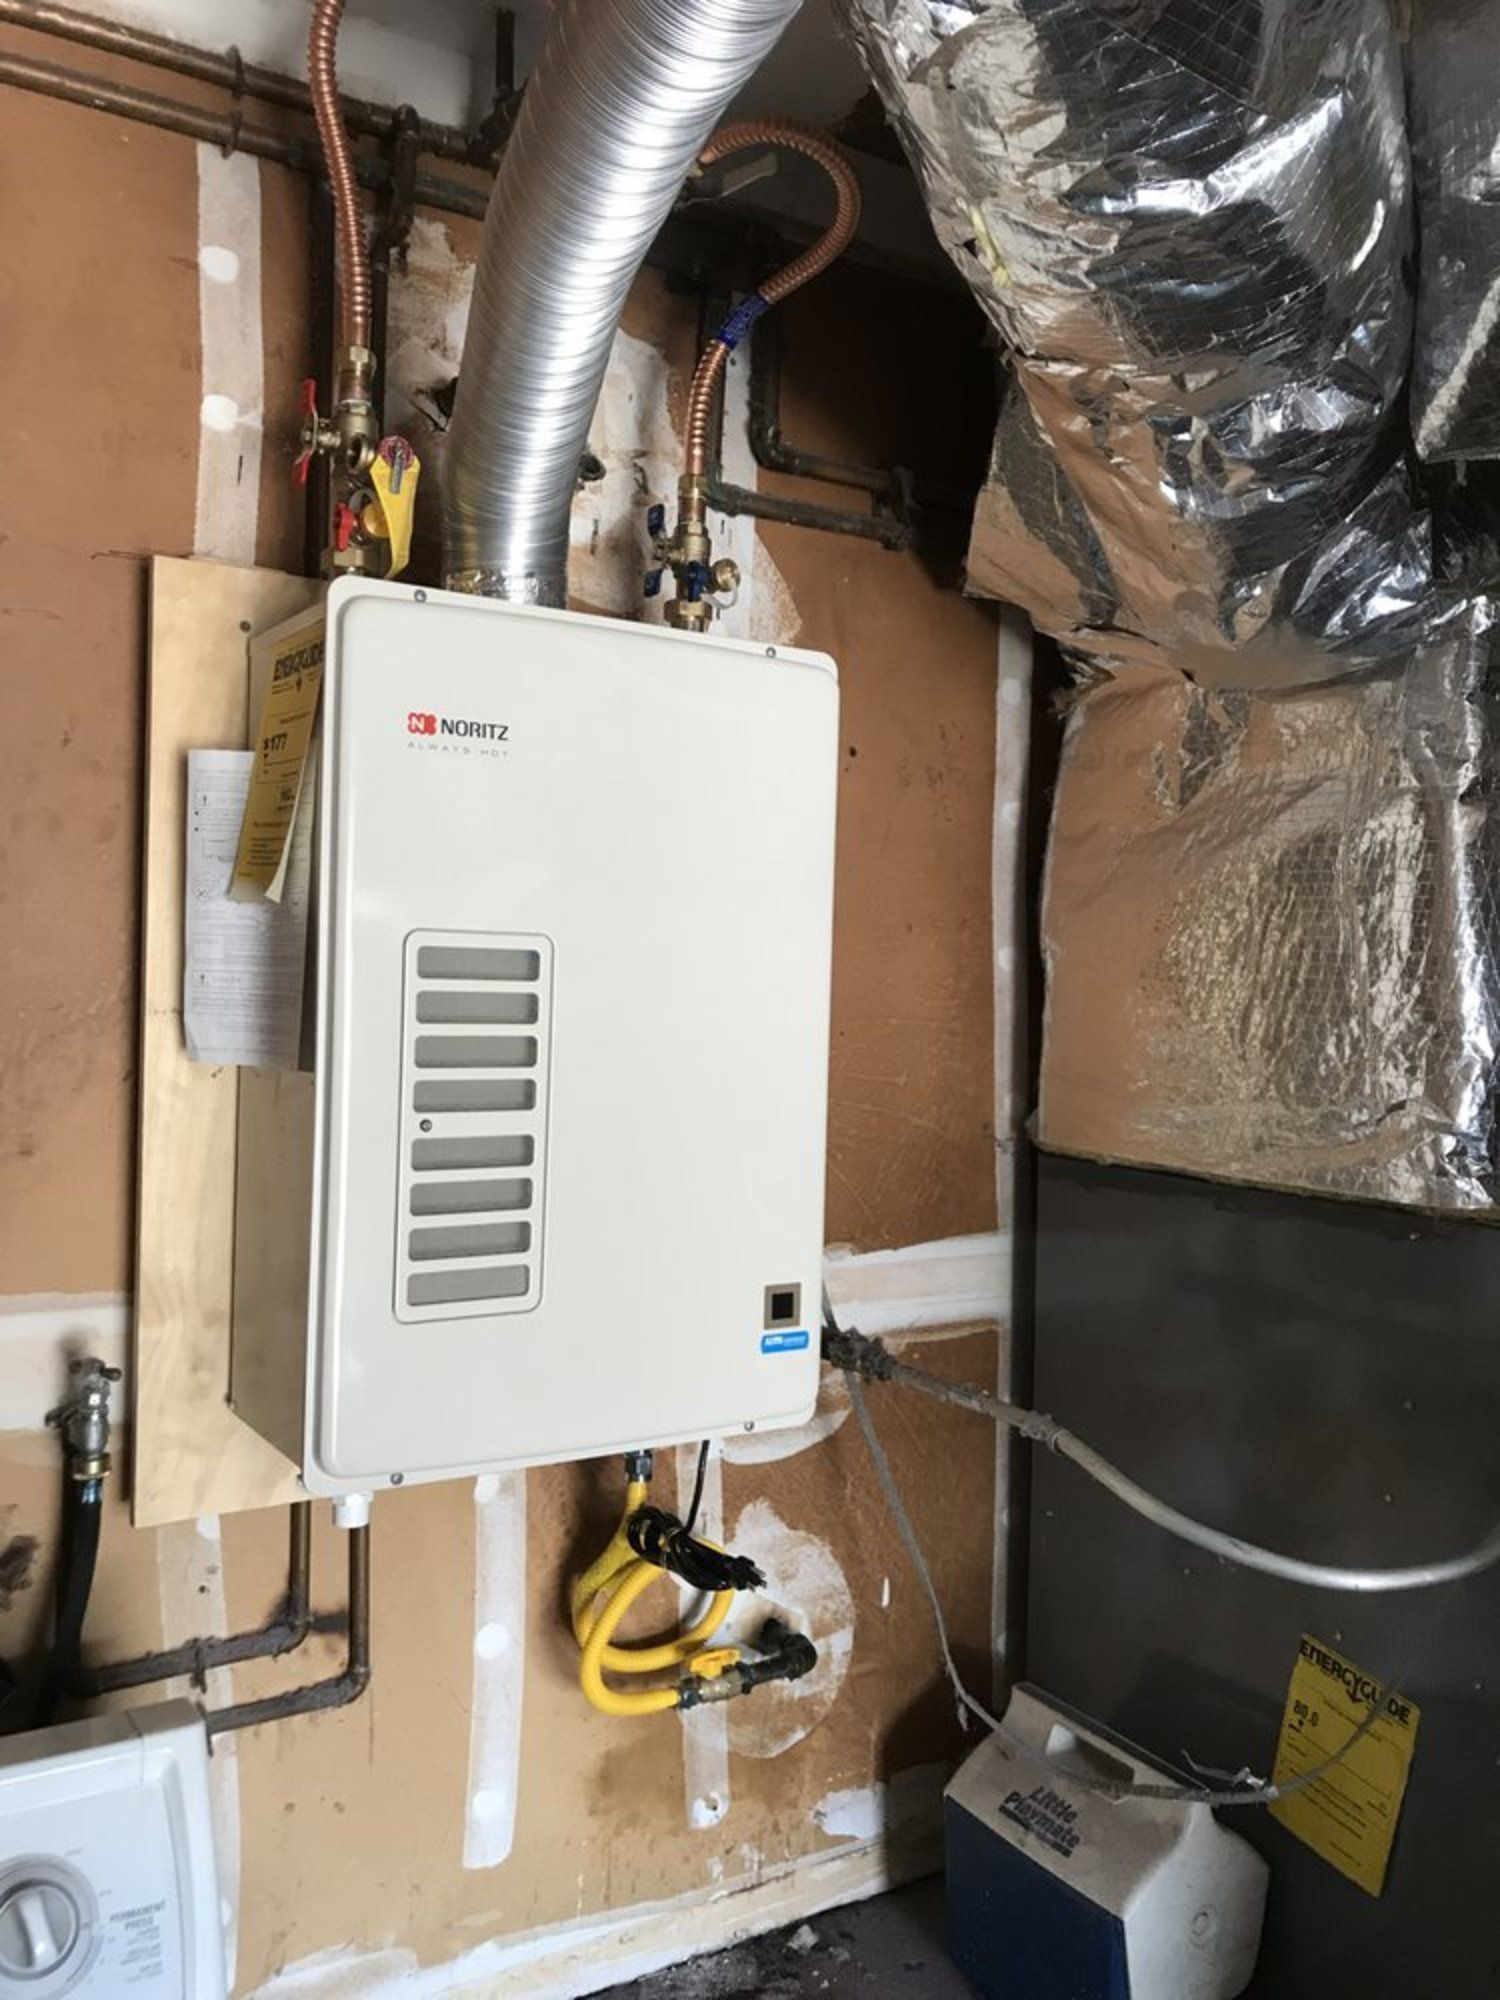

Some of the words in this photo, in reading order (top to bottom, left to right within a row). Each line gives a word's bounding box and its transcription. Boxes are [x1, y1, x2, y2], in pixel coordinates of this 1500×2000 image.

[441, 718, 509, 741] NORITZ
[407, 741, 471, 755] ALWAYS
[1029, 1786, 1077, 1823] Little
[1003, 1791, 1080, 1849] Playmate
